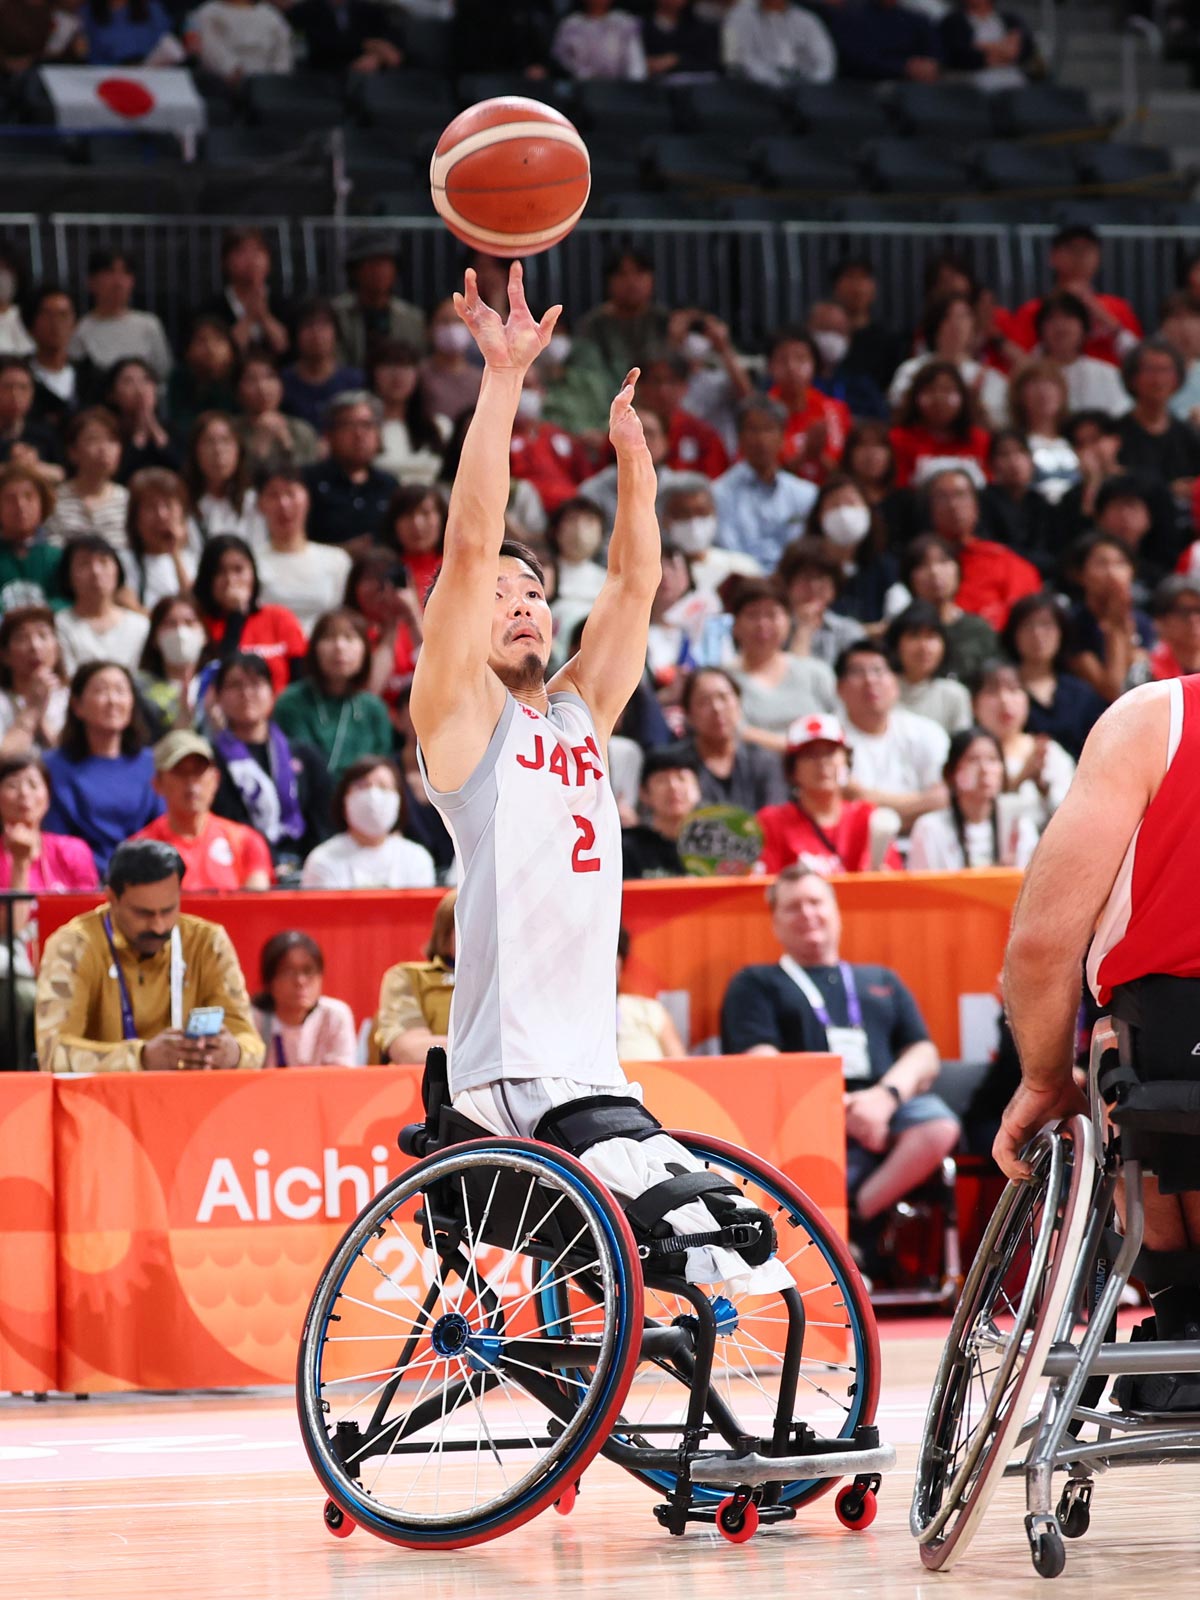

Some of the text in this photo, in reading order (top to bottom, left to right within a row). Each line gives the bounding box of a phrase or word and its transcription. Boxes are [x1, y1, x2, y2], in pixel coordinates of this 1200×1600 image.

[571, 814, 601, 873] 2
[195, 1144, 390, 1223] Aichi
[373, 1236, 535, 1302] 202
